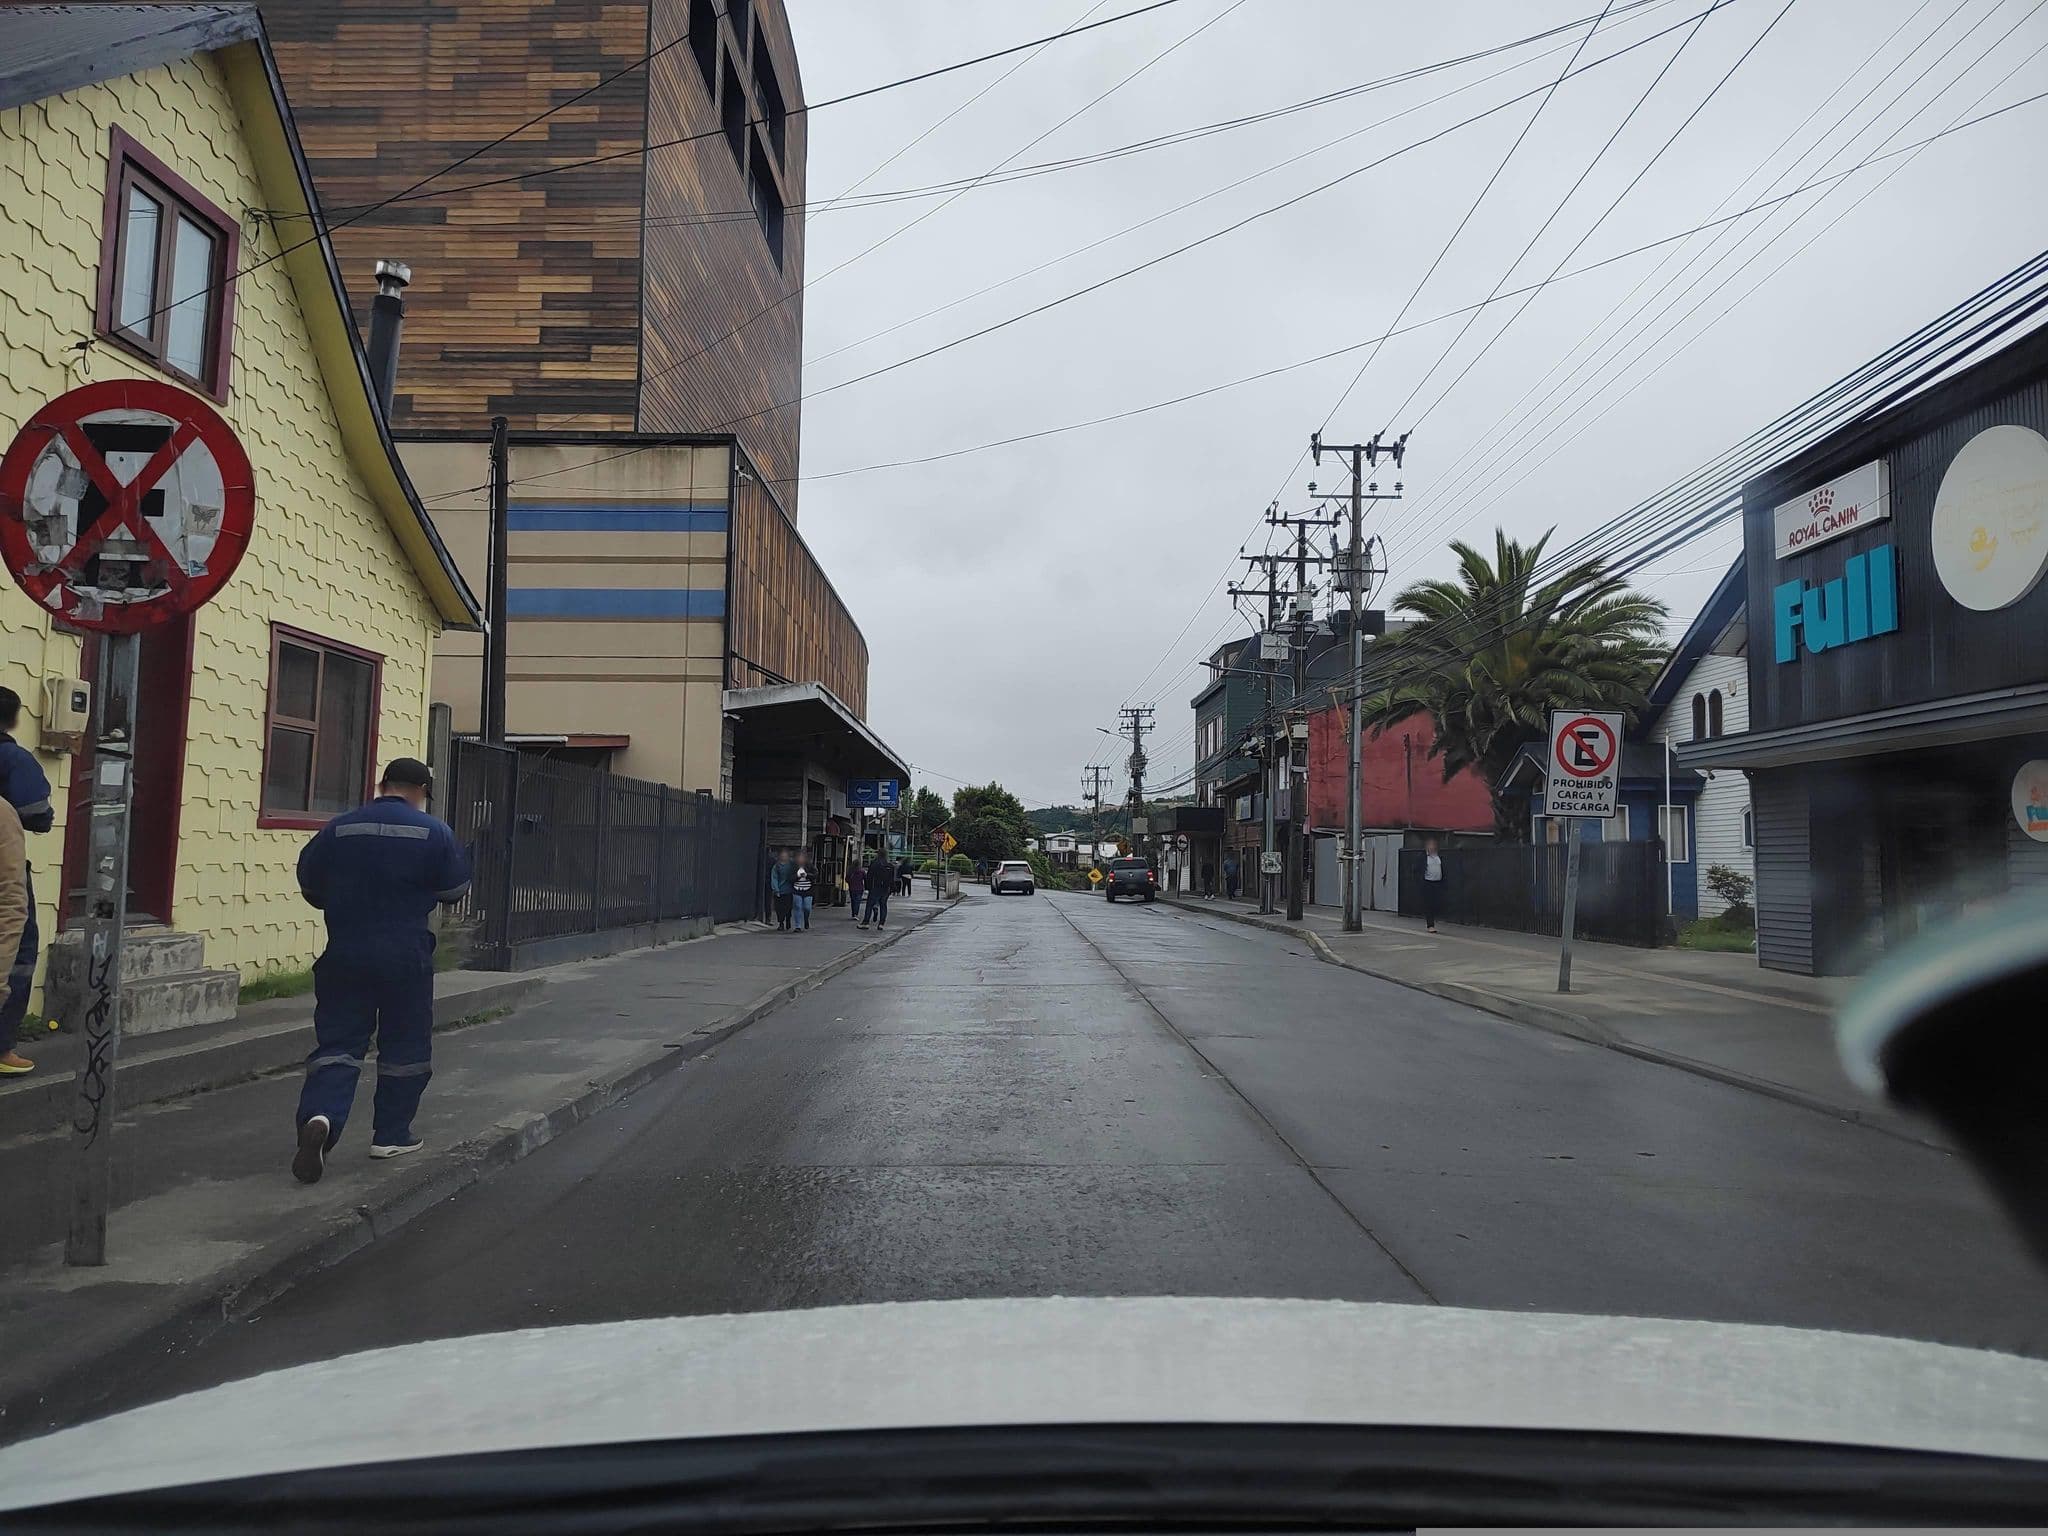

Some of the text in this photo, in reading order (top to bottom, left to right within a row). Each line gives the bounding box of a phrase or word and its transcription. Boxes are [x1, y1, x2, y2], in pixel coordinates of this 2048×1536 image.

[1788, 504, 1858, 548] ROYAL CANIN
[1775, 544, 1897, 665] Full
[1574, 731, 1600, 766] E
[878, 782, 891, 800] E
[1552, 779, 1613, 789] PROHIBIDO
[1557, 790, 1604, 800] CARGA Y
[1552, 801, 1610, 812] DESCARGA
